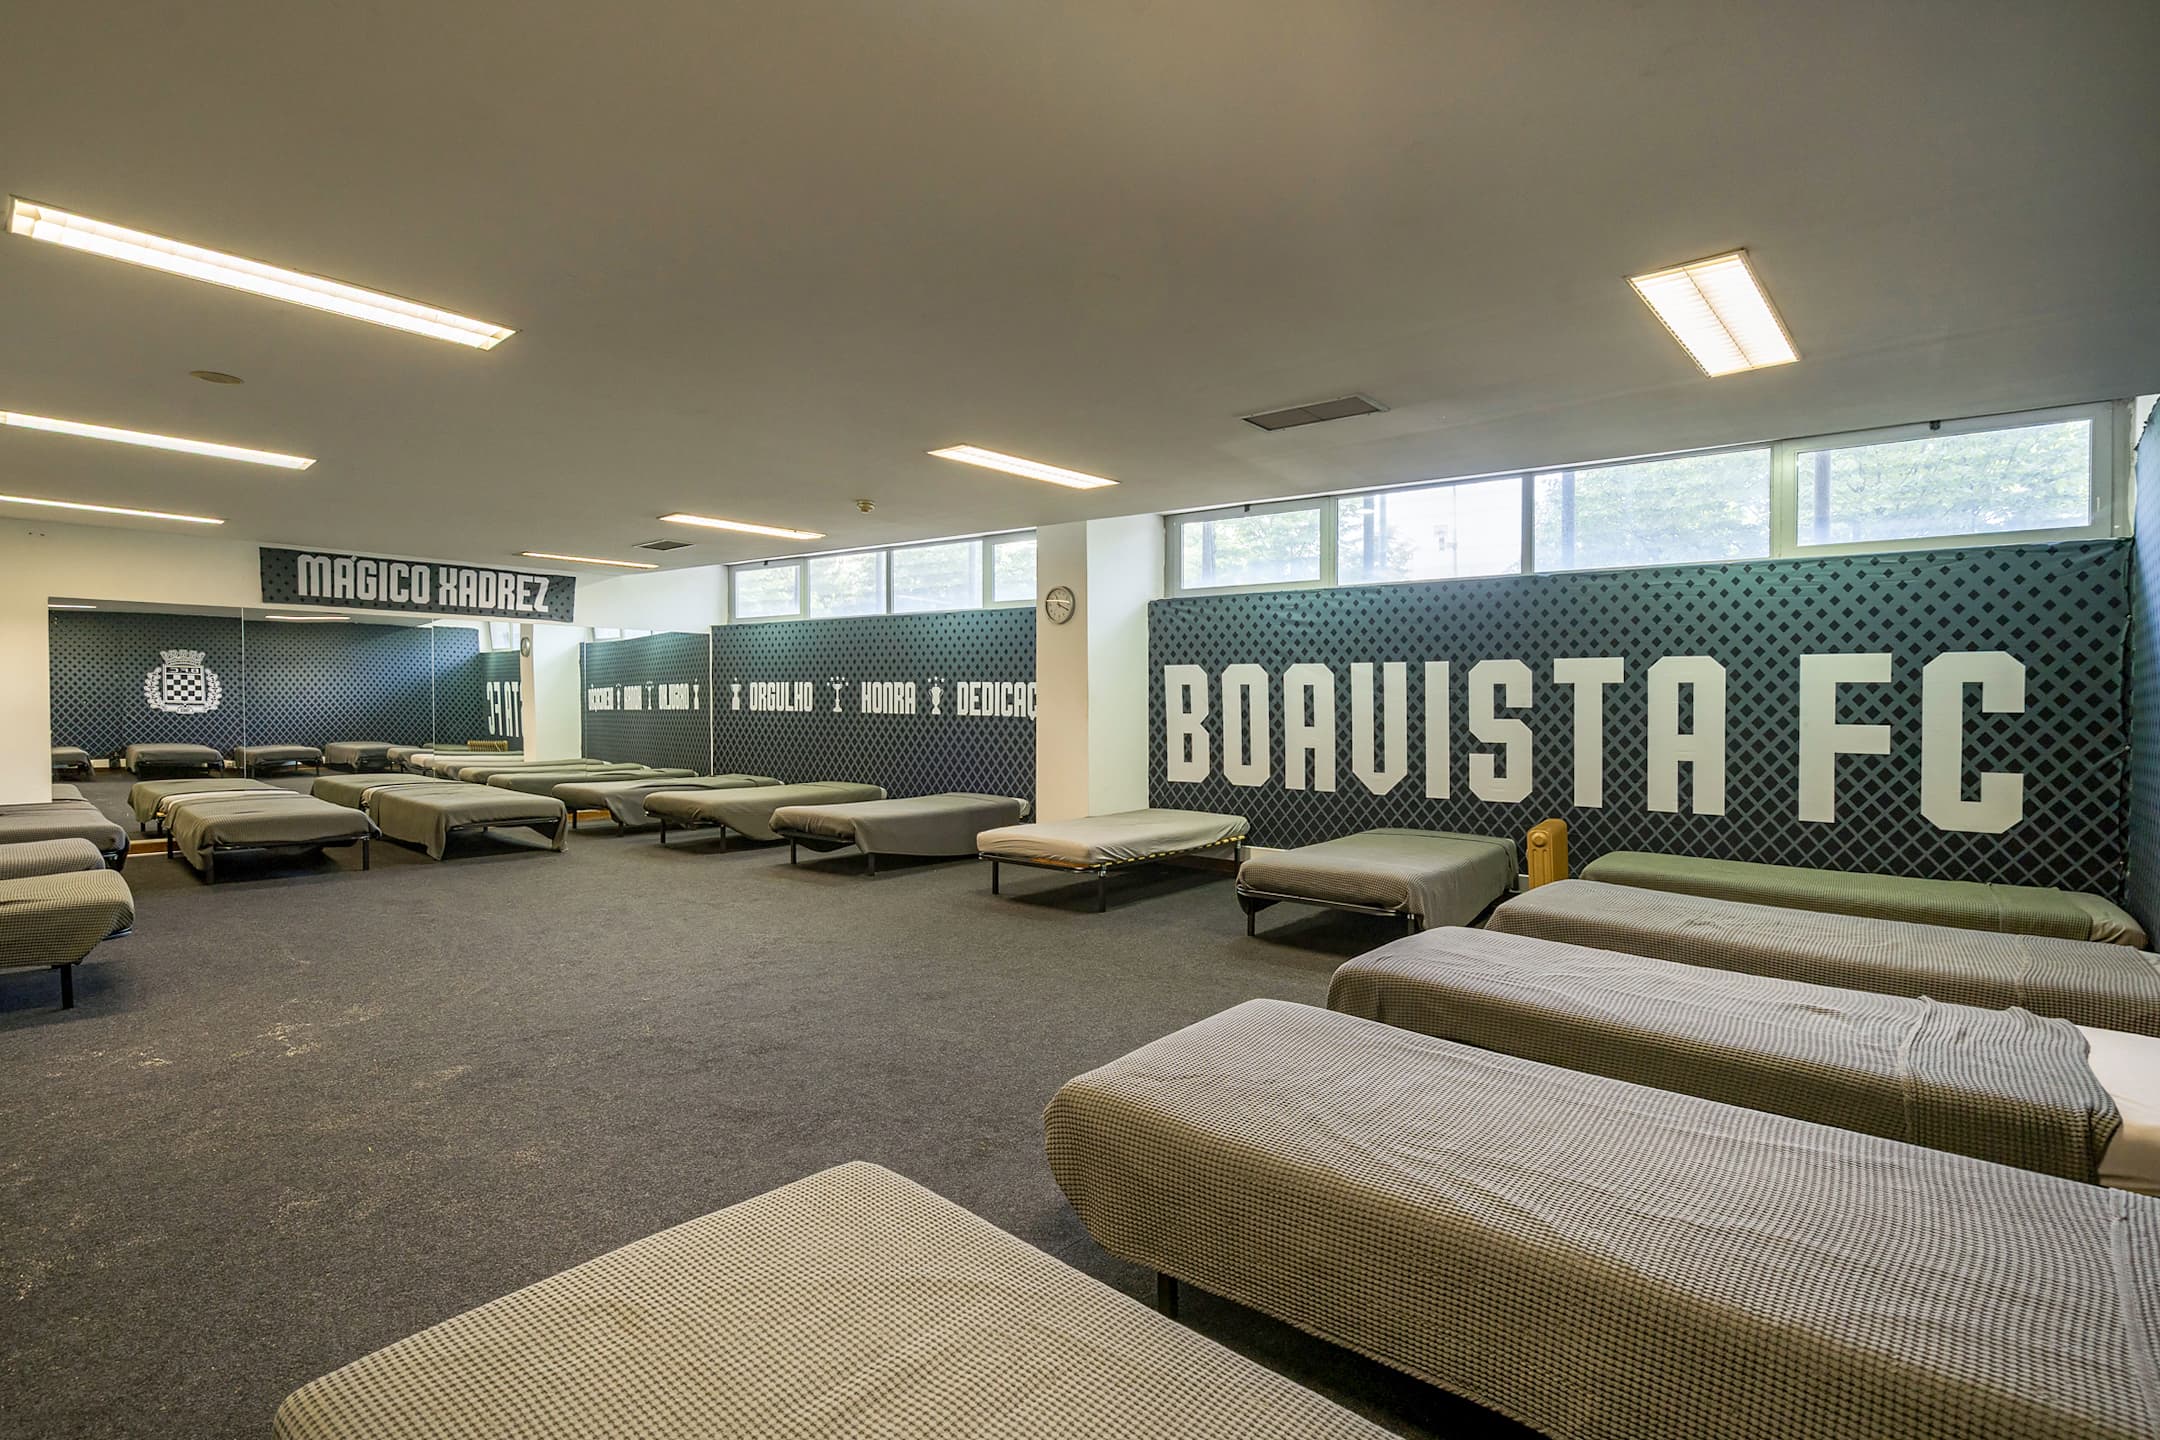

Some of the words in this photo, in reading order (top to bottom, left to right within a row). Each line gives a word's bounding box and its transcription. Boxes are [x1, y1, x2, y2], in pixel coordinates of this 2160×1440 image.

[297, 554, 431, 604] MÁGICO
[439, 566, 549, 612] XADREZ
[750, 682, 813, 711] ORGULHO
[861, 682, 916, 714] HONRA
[1165, 656, 1727, 816] BOAVISTA
[1800, 651, 2026, 834] FC
